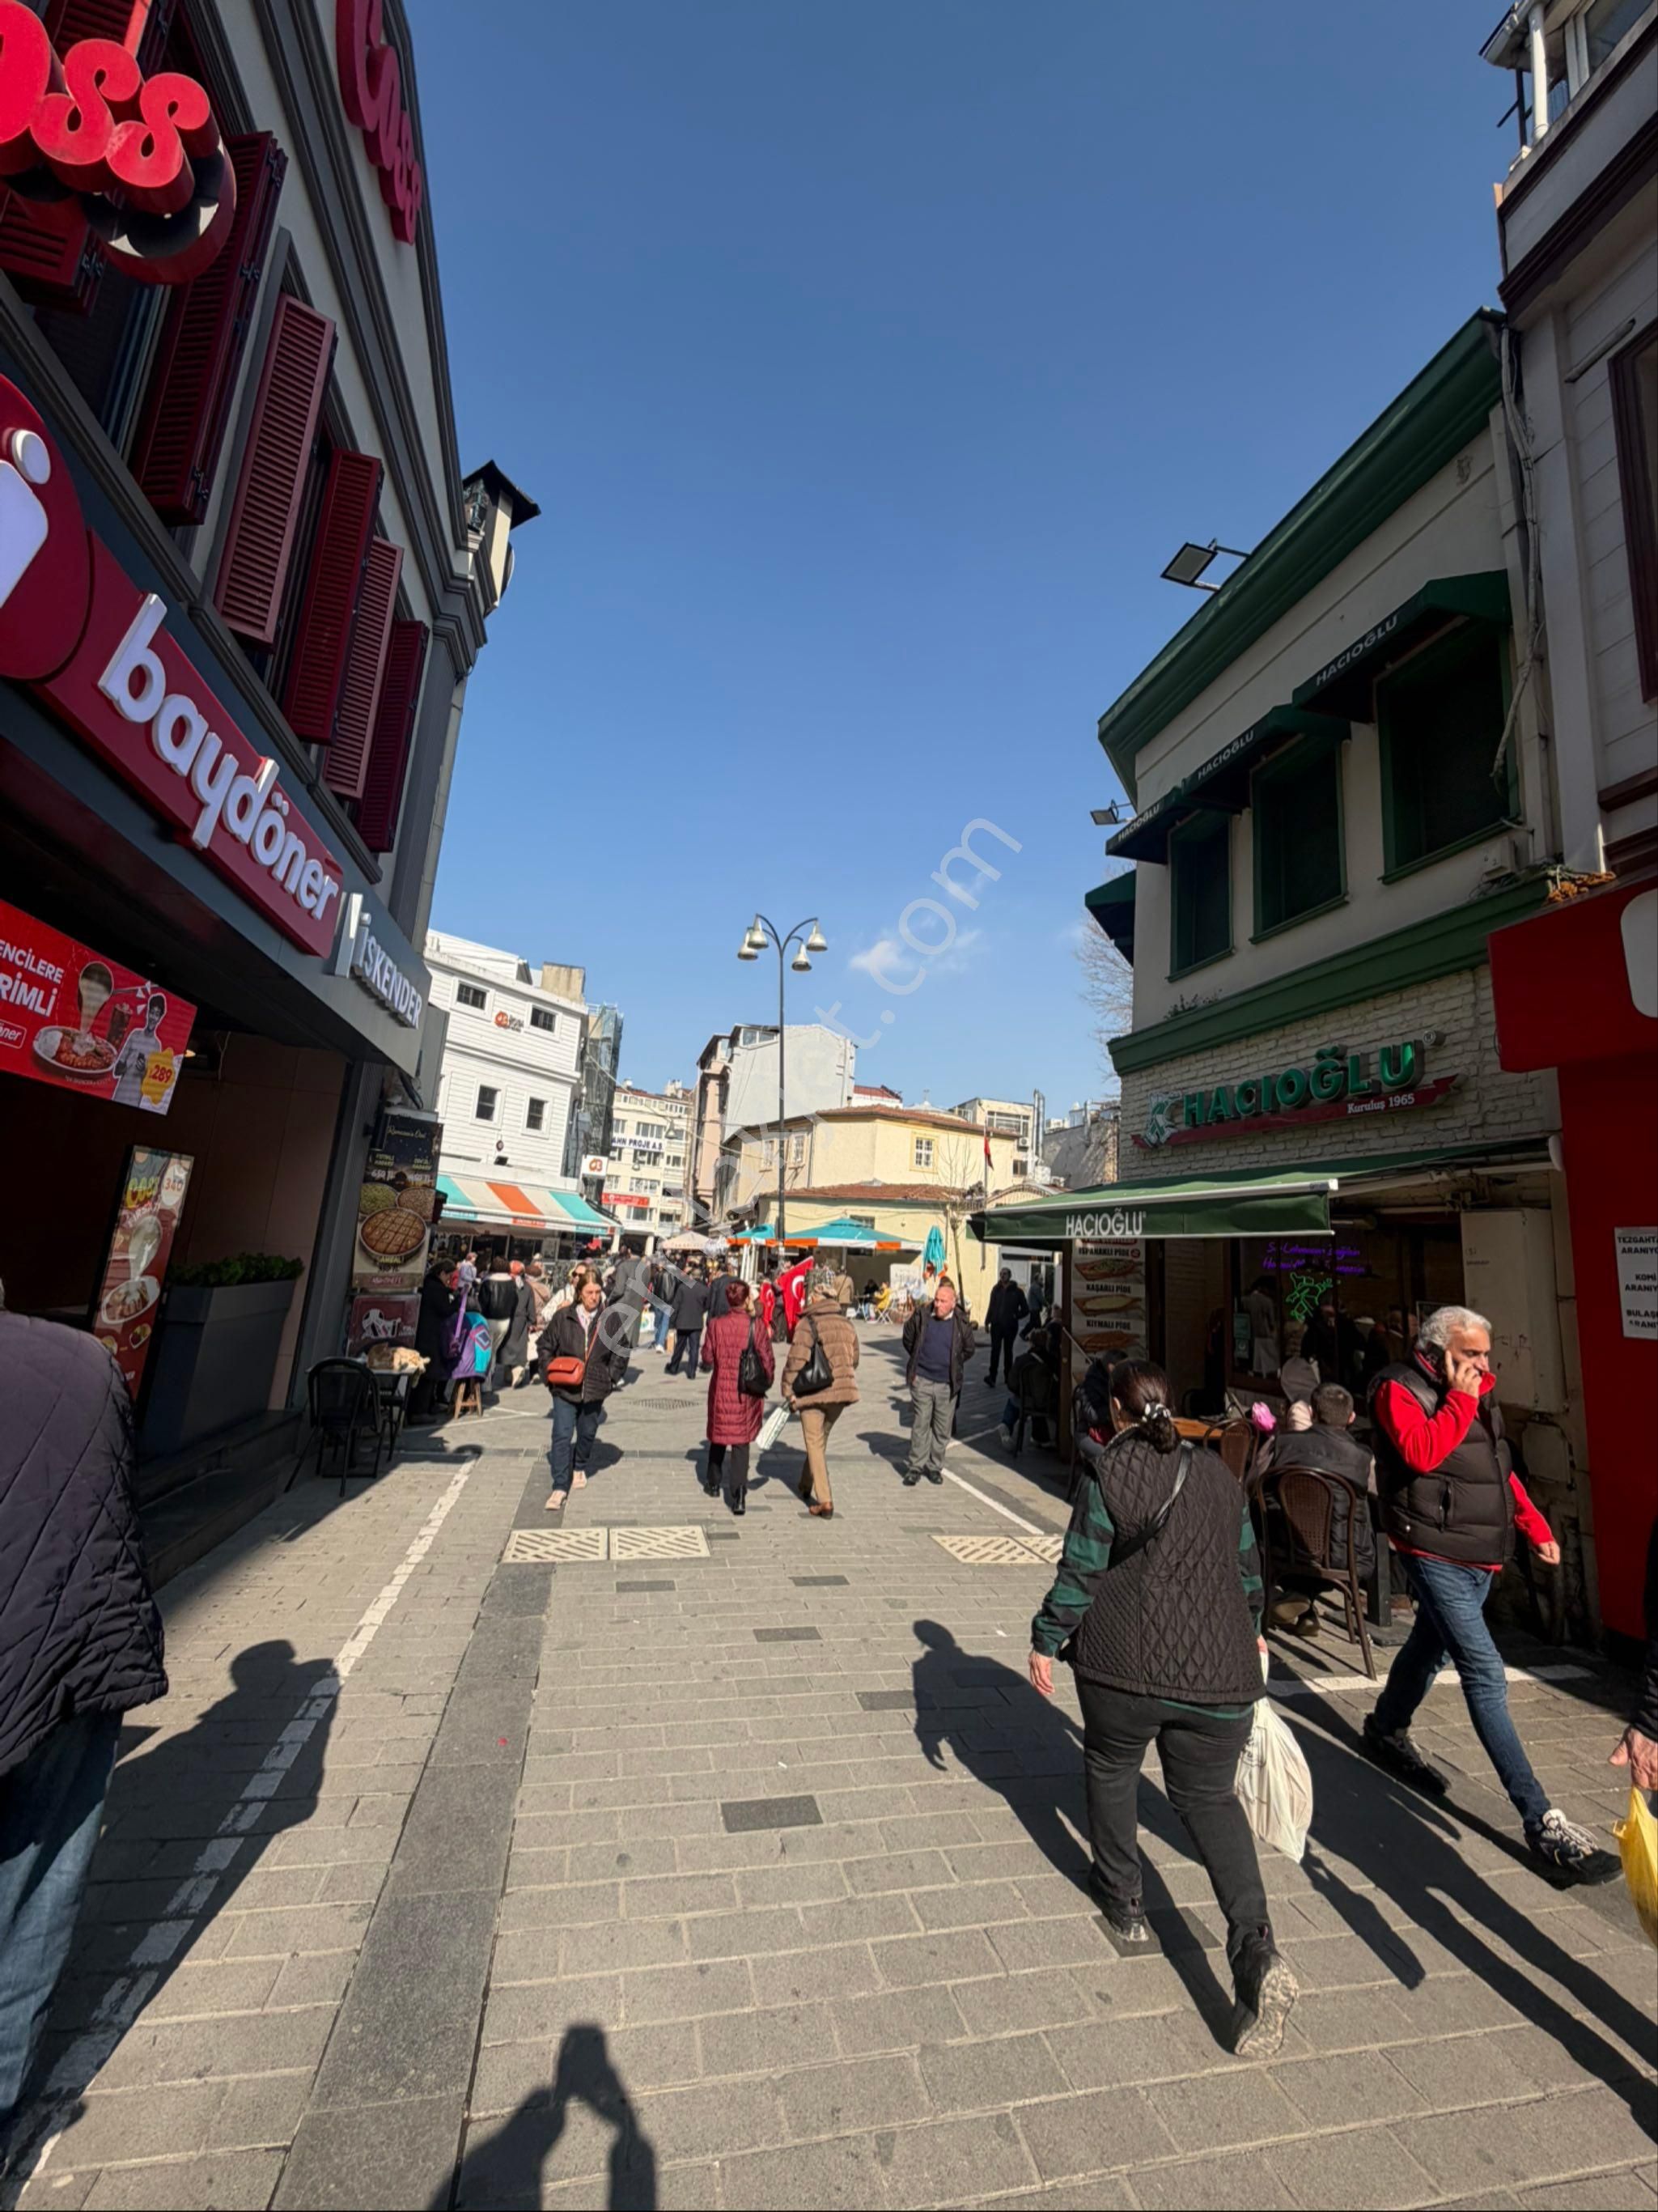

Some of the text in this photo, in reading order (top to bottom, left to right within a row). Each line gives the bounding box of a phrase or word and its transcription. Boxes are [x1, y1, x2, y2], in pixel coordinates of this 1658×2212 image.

[98, 593, 338, 920] baydöner
[353, 912, 422, 1030] İSKENDER
[1183, 1042, 1417, 1127] HACIOĞLU
[1346, 1093, 1415, 1114] Kuruluş 1965
[1635, 1273, 1656, 1281] KOMİ
[1086, 1284, 1131, 1293] KAŞARLI PİDE
[1626, 1309, 1657, 1320] BULAŞ
